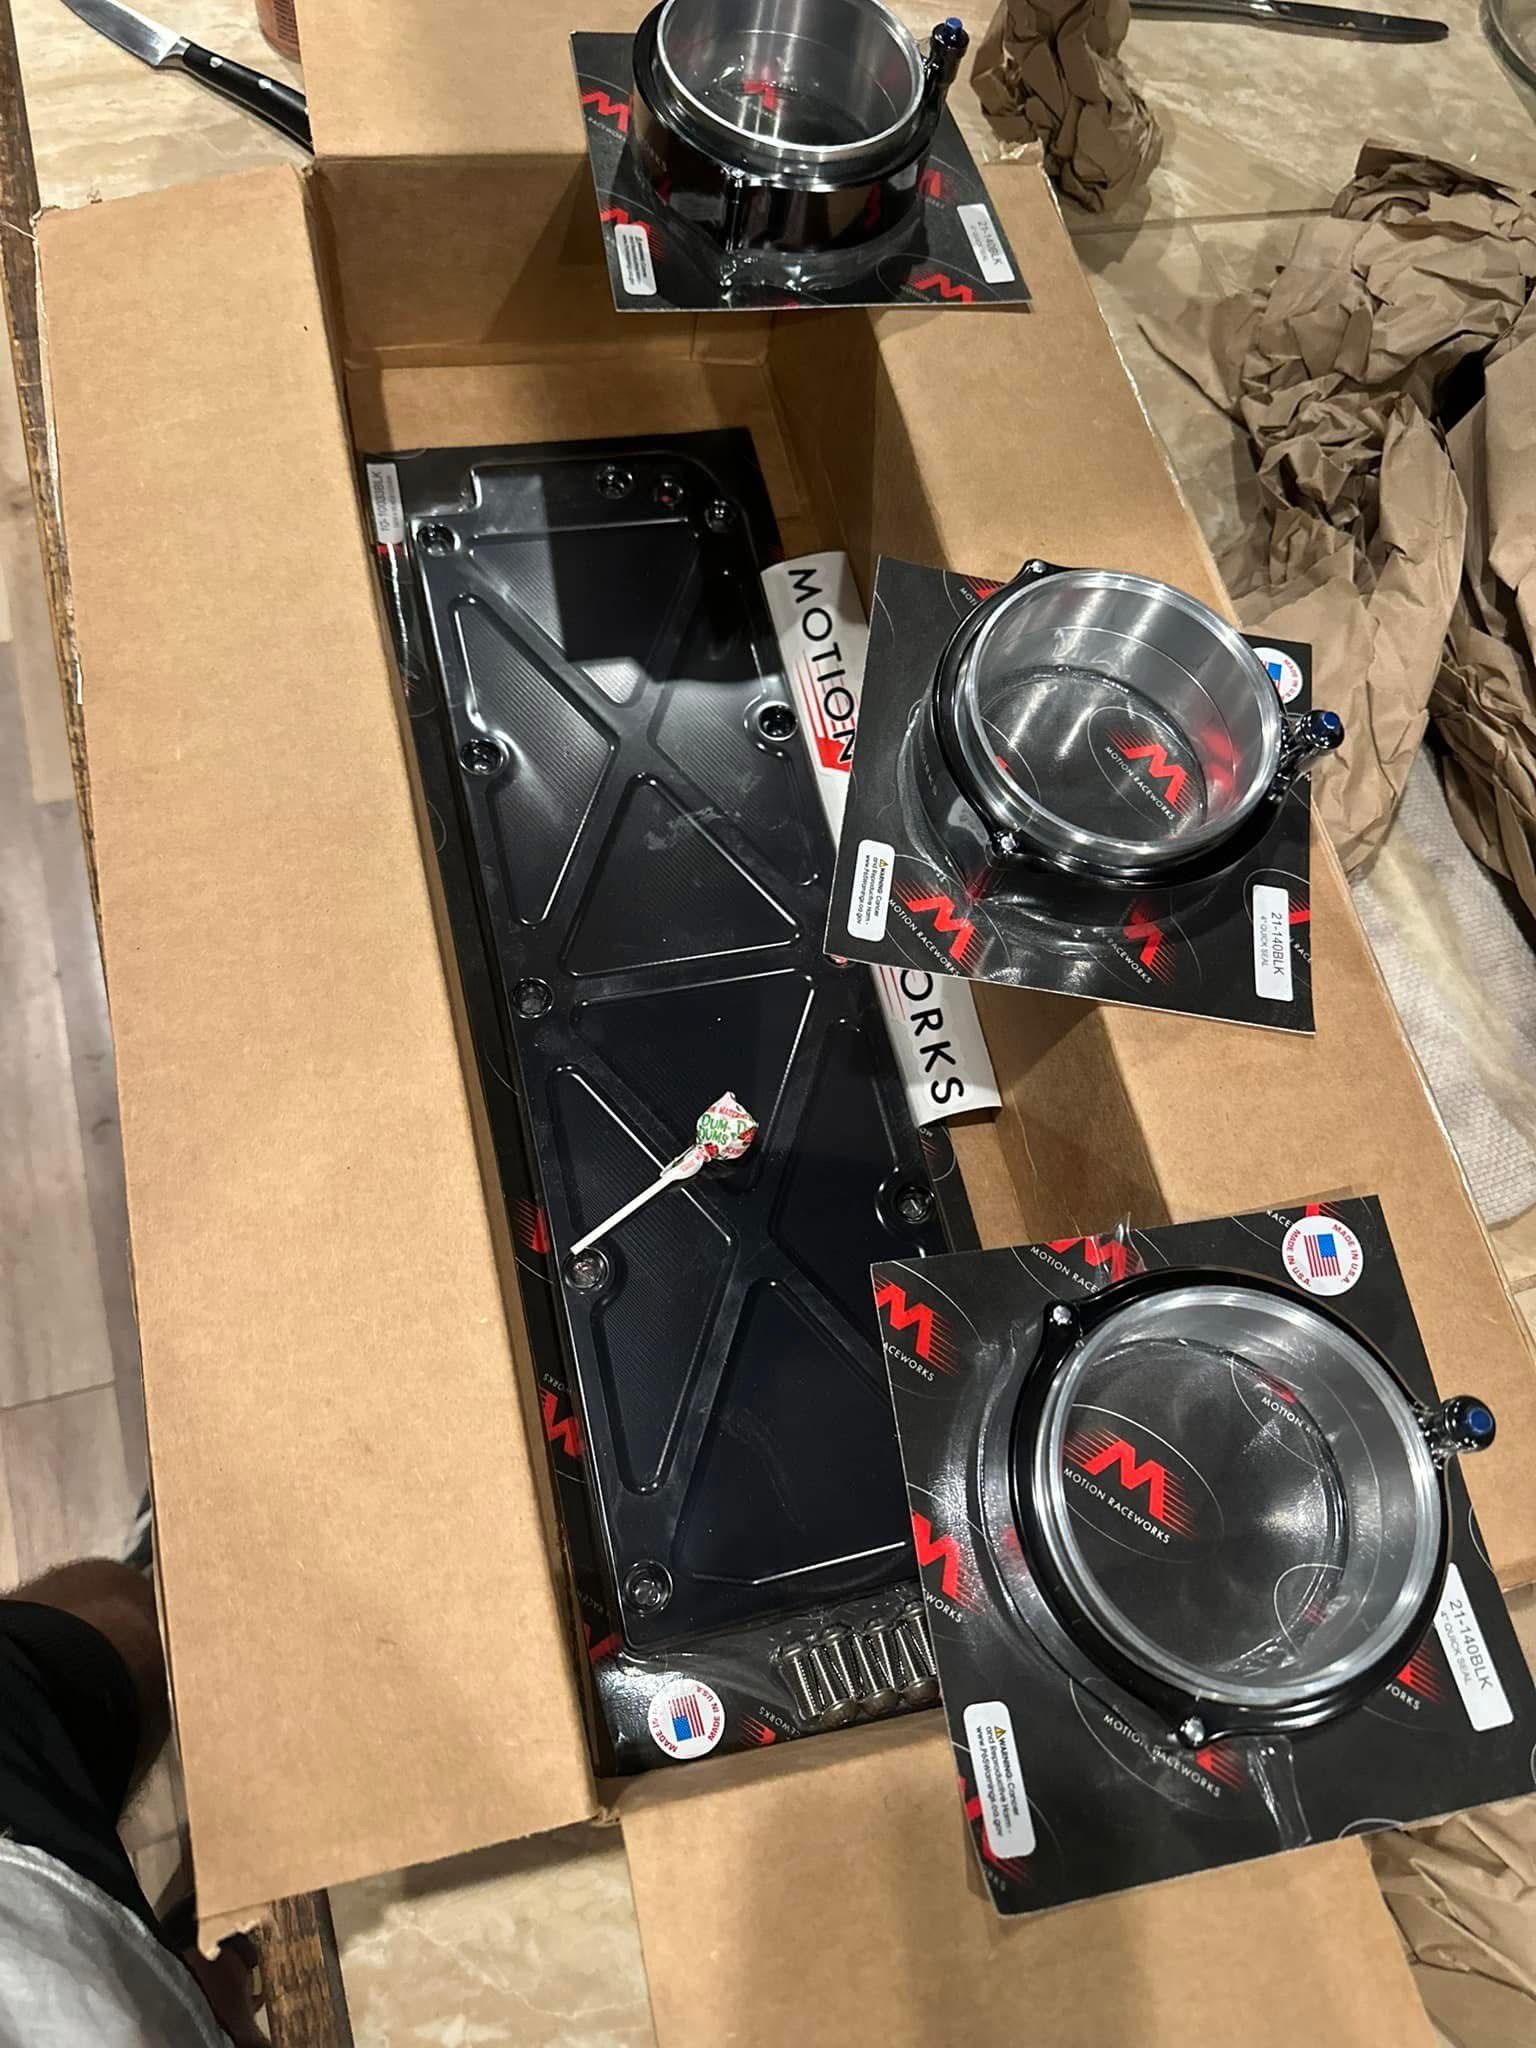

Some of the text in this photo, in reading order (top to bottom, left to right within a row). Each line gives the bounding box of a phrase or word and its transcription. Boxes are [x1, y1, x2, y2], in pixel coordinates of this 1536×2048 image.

[788, 568, 856, 762] MOTION
[1103, 746, 1176, 821] MOTION RACEWORKS
[888, 898, 961, 977] MOTION RACEWORKS
[1271, 911, 1285, 977] 21-140BLK
[1286, 1227, 1301, 1252] MADE
[1332, 1223, 1356, 1247] MADE
[1351, 1249, 1360, 1261] IN
[1030, 1245, 1100, 1294] MOTION RACE
[1287, 1254, 1295, 1266] IN
[1261, 1396, 1304, 1427] MOTION
[1063, 1467, 1172, 1545] MOTION RACEWORKS
[1449, 1599, 1494, 1691] 21-140BLK
[711, 1702, 720, 1713] IN
[655, 1729, 678, 1753] MADE
[707, 1715, 721, 1741] MADE
[985, 1726, 996, 1744] and
[1103, 1713, 1144, 1747] MOTIO
[989, 1745, 1007, 1802] Reproductive
[1001, 1803, 1012, 1828] Harm
[1007, 1782, 1020, 1816] Cancer
